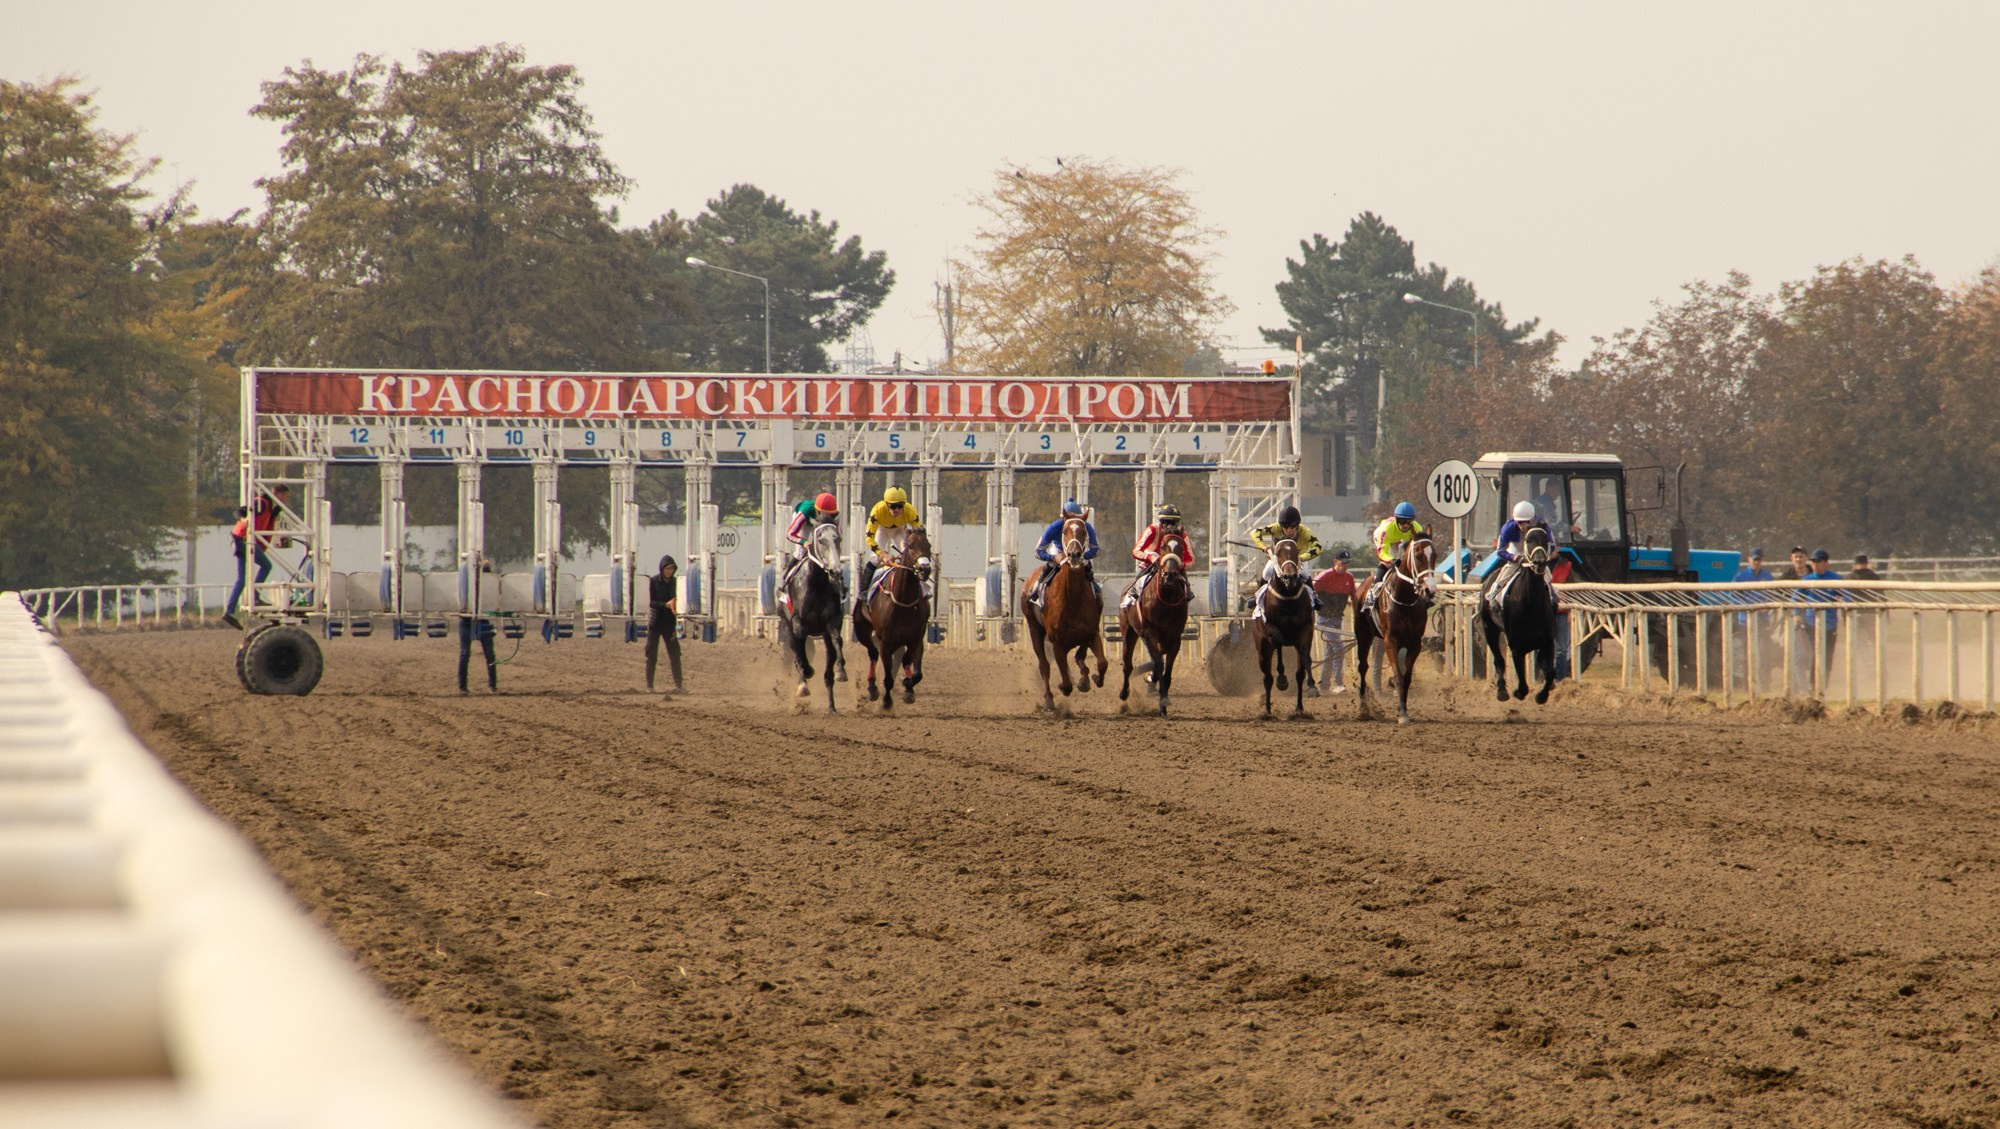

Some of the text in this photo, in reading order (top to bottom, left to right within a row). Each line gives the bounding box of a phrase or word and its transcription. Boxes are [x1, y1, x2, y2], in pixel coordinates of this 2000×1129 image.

[868, 380, 1192, 423] ИППОДРОМ
[350, 428, 369, 443] 12
[429, 428, 444, 443] 11
[505, 430, 523, 445] 10
[584, 431, 595, 445] 9
[661, 431, 672, 447] 8
[736, 432, 747, 447] 7
[815, 433, 826, 448] 6
[889, 434, 900, 449] 5
[963, 434, 976, 449] 4
[1040, 435, 1051, 450] 3
[1115, 435, 1126, 450] 2
[1192, 435, 1200, 450] 1
[1434, 474, 1471, 503] 1800
